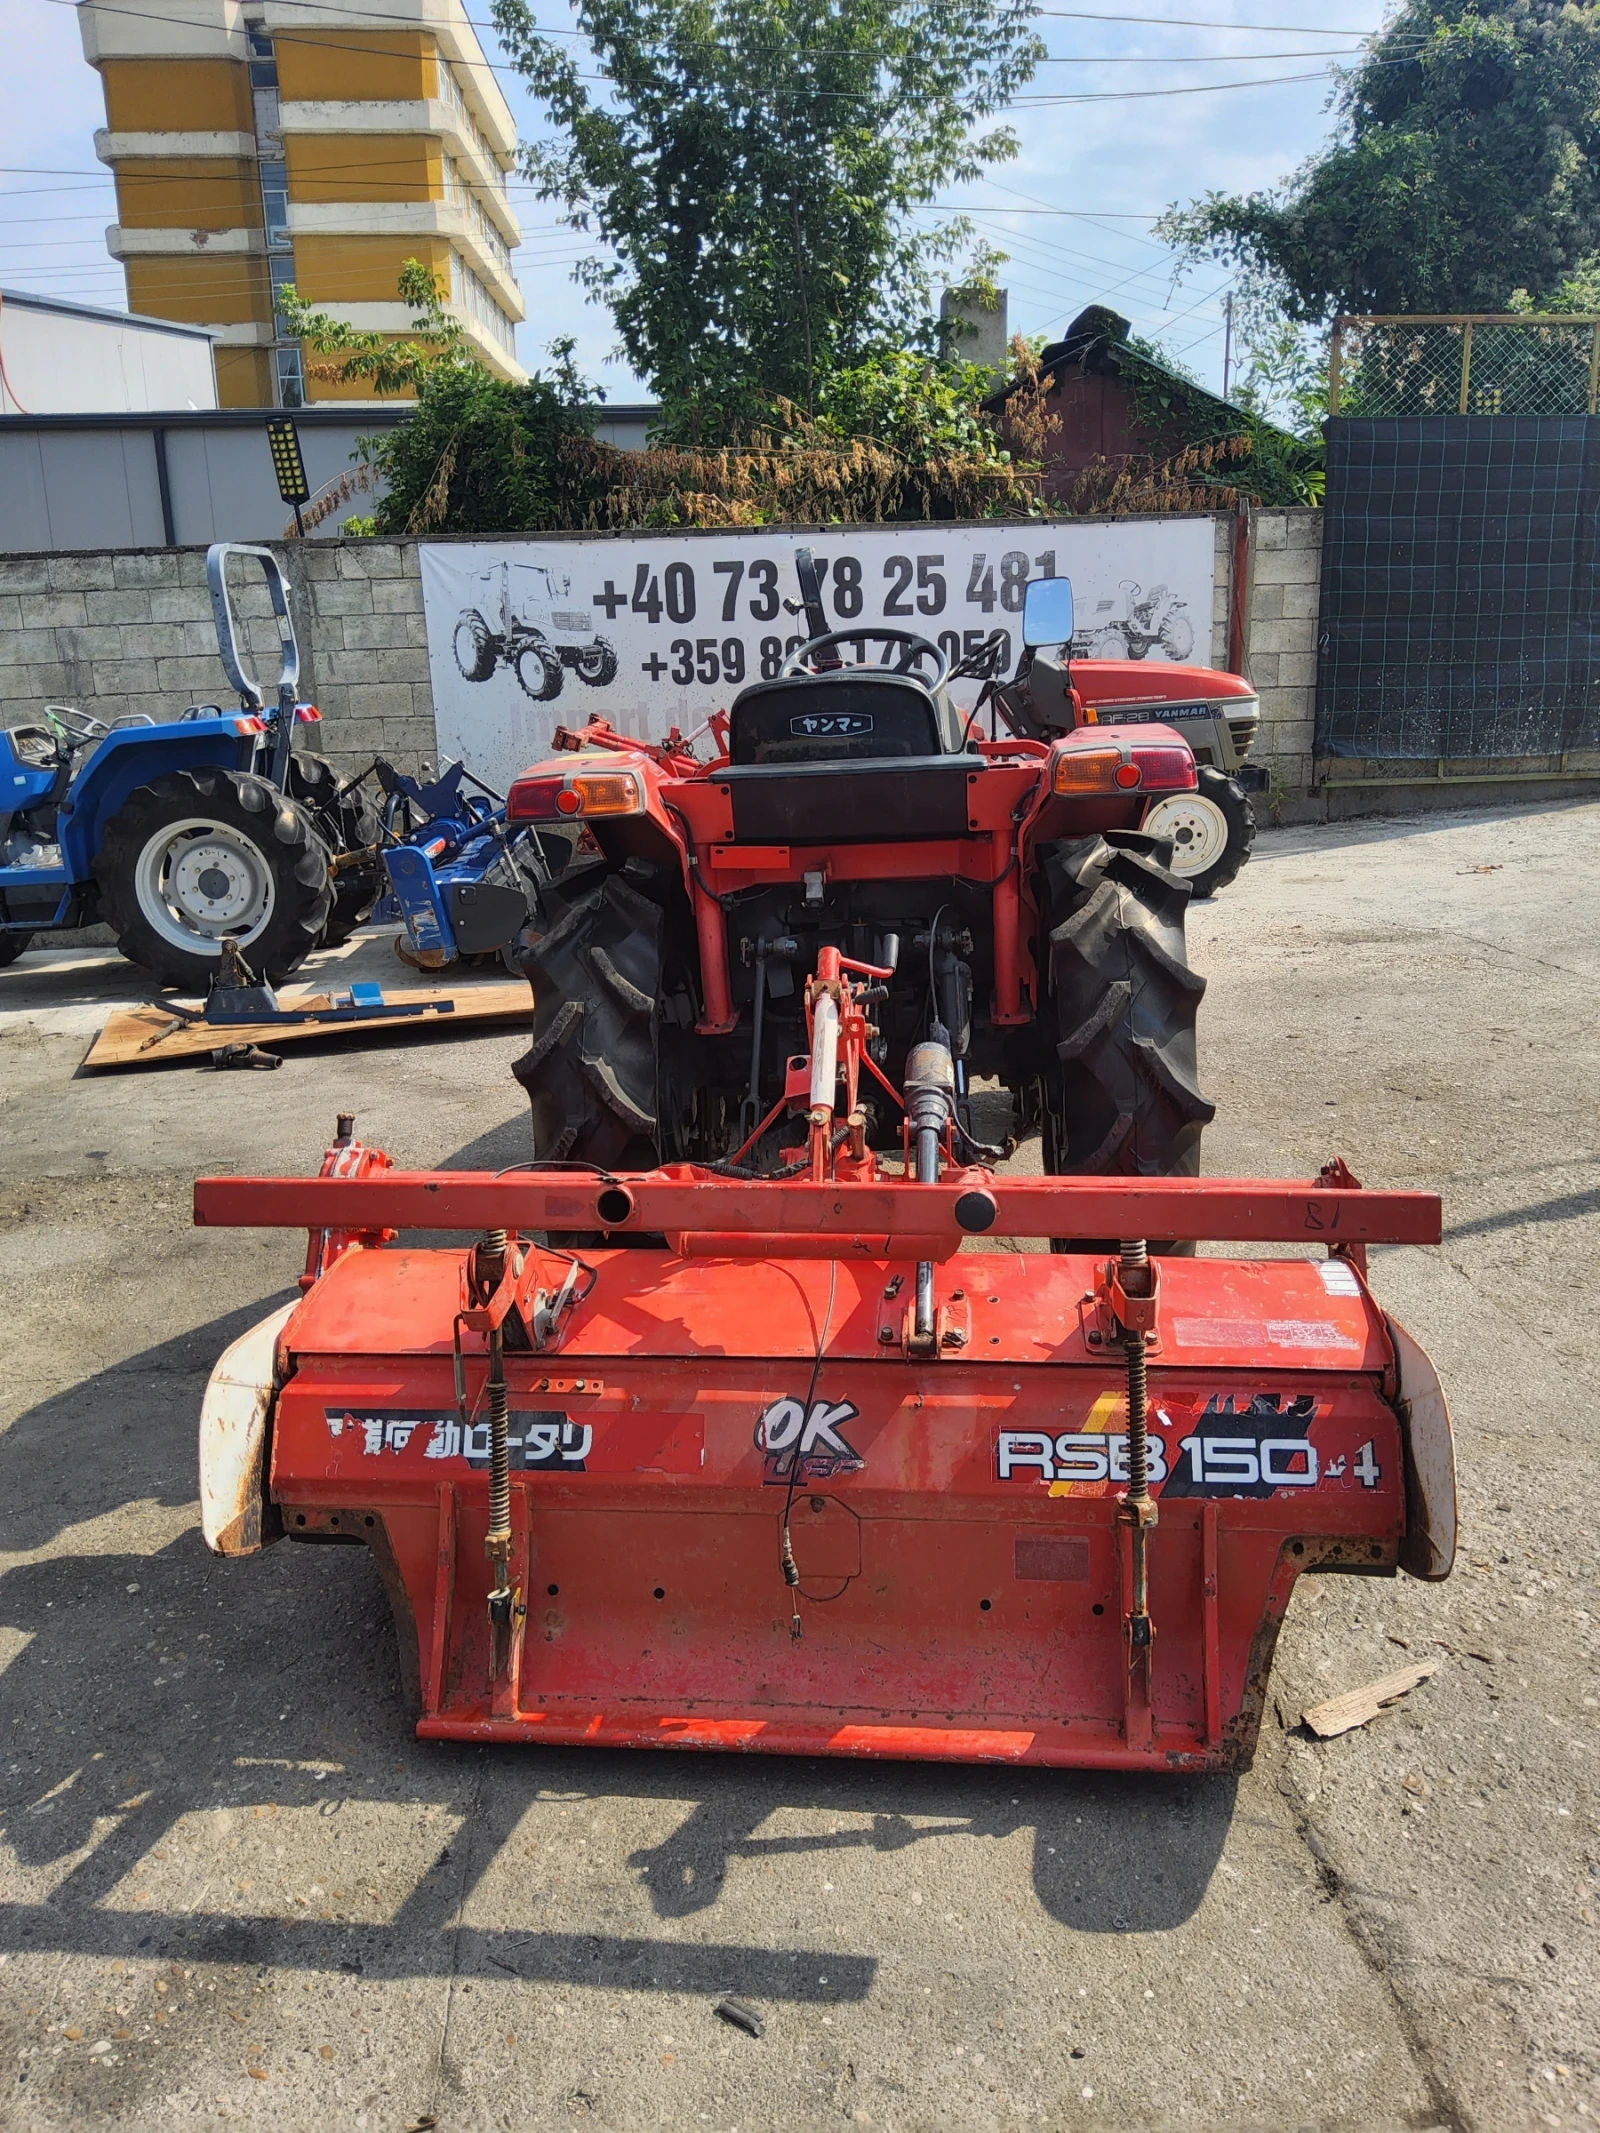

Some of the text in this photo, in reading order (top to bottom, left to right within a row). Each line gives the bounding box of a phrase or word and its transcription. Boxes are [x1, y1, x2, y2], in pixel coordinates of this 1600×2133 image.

[593, 562, 696, 624] +40
[713, 559, 780, 622] 73
[883, 555, 947, 616] 25
[641, 637, 745, 686] +359
[802, 717, 862, 733] ヤンマー
[1154, 707, 1207, 718] YANMAR
[757, 1400, 857, 1456] OK
[999, 1432, 1167, 1483] RSB
[1180, 1437, 1318, 1485] 150
